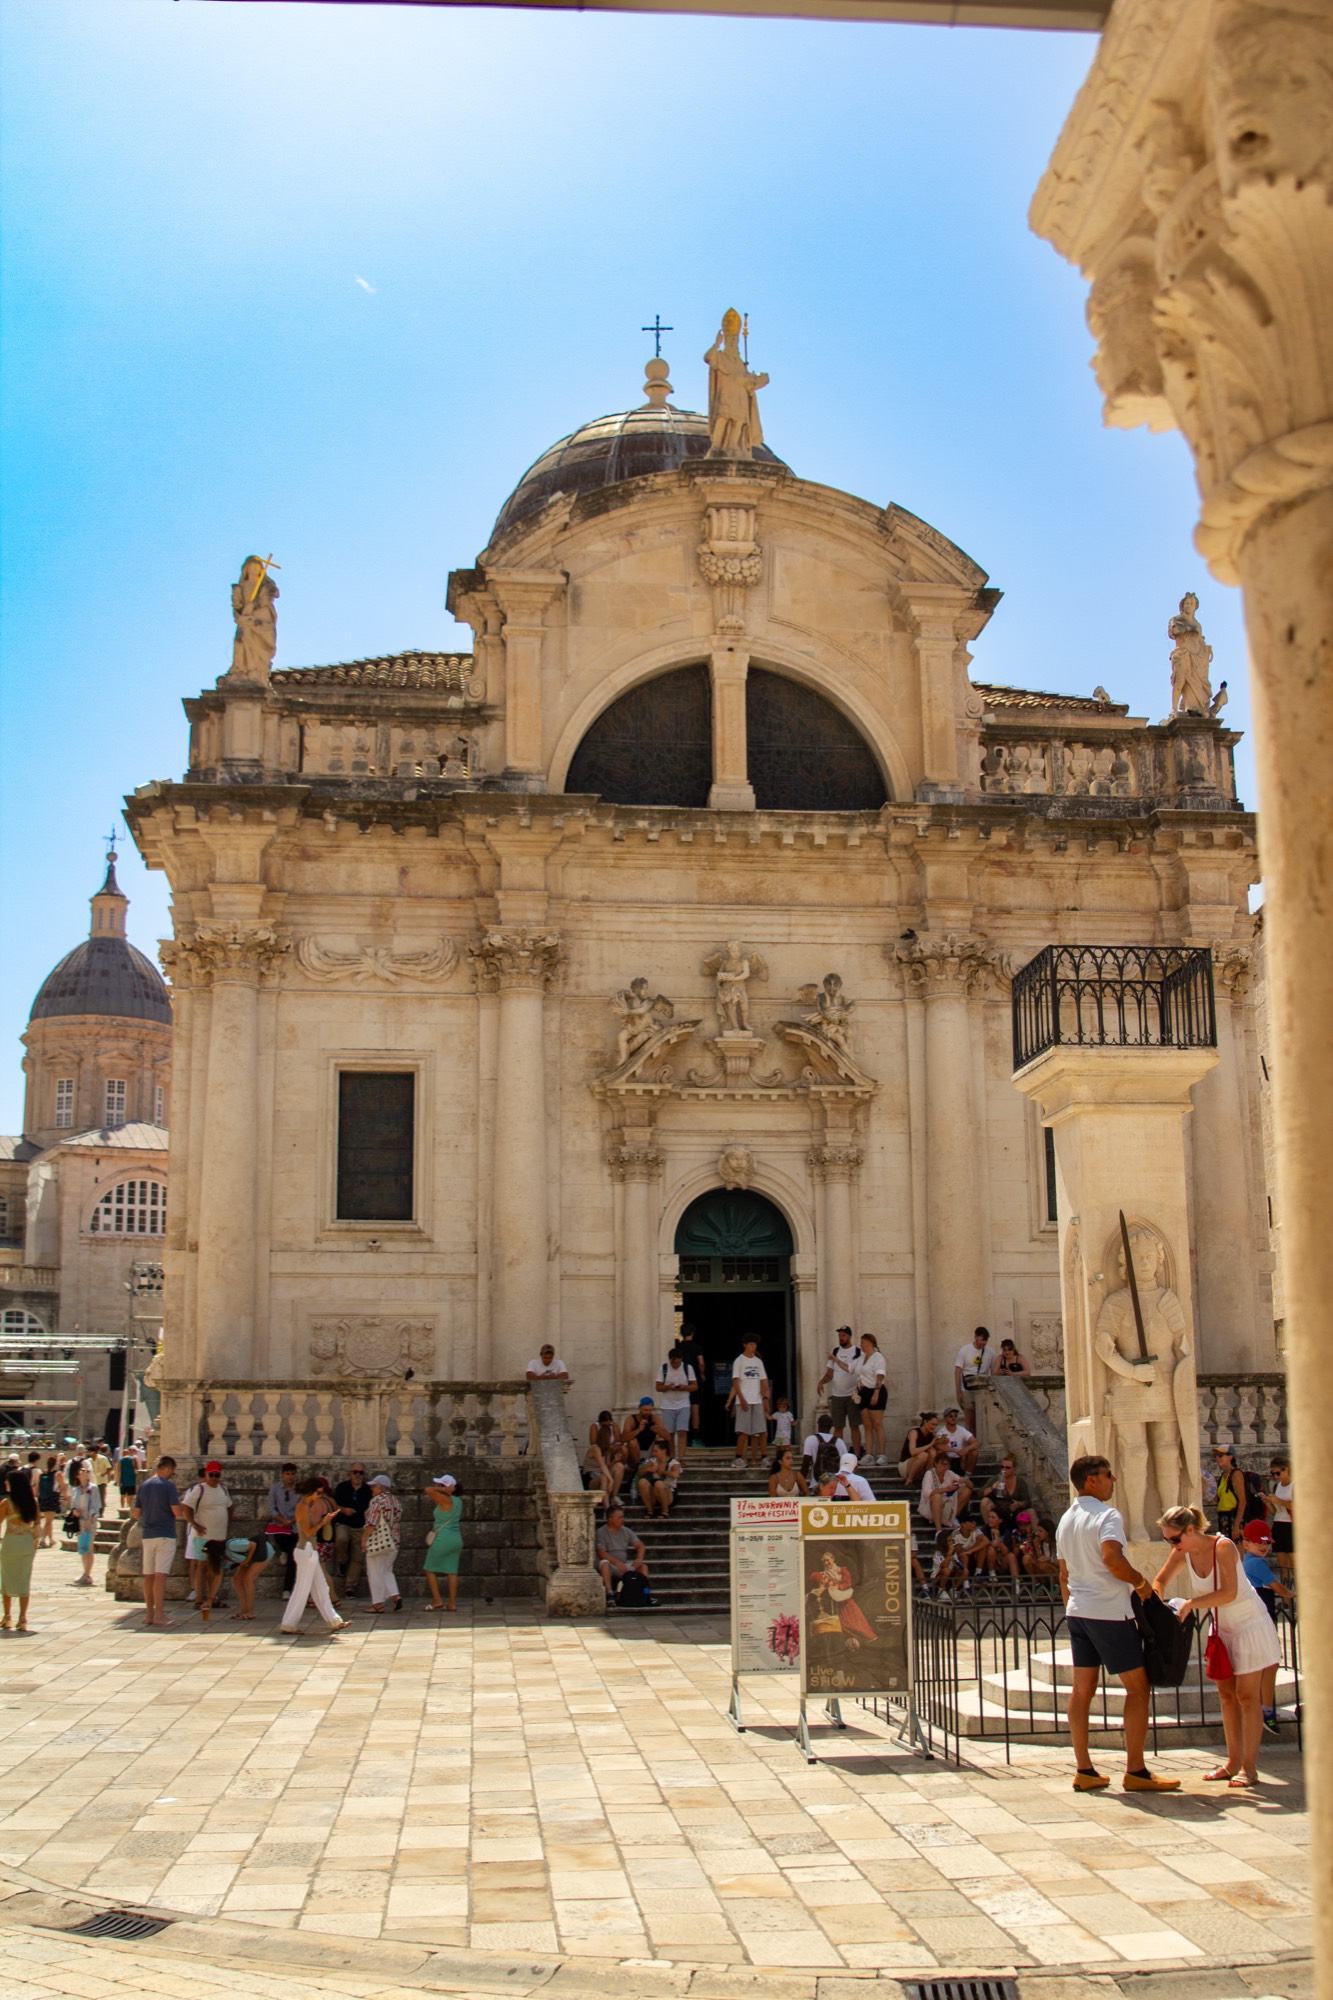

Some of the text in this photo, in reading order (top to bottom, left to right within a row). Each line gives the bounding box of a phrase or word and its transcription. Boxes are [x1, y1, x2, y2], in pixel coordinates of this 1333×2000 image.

[832, 1506, 869, 1514] Folk dance
[832, 1513, 900, 1527] LINĐO
[884, 1545, 900, 1612] LINĐO
[810, 1665, 834, 1675] Live
[810, 1676, 856, 1687] SHOW
